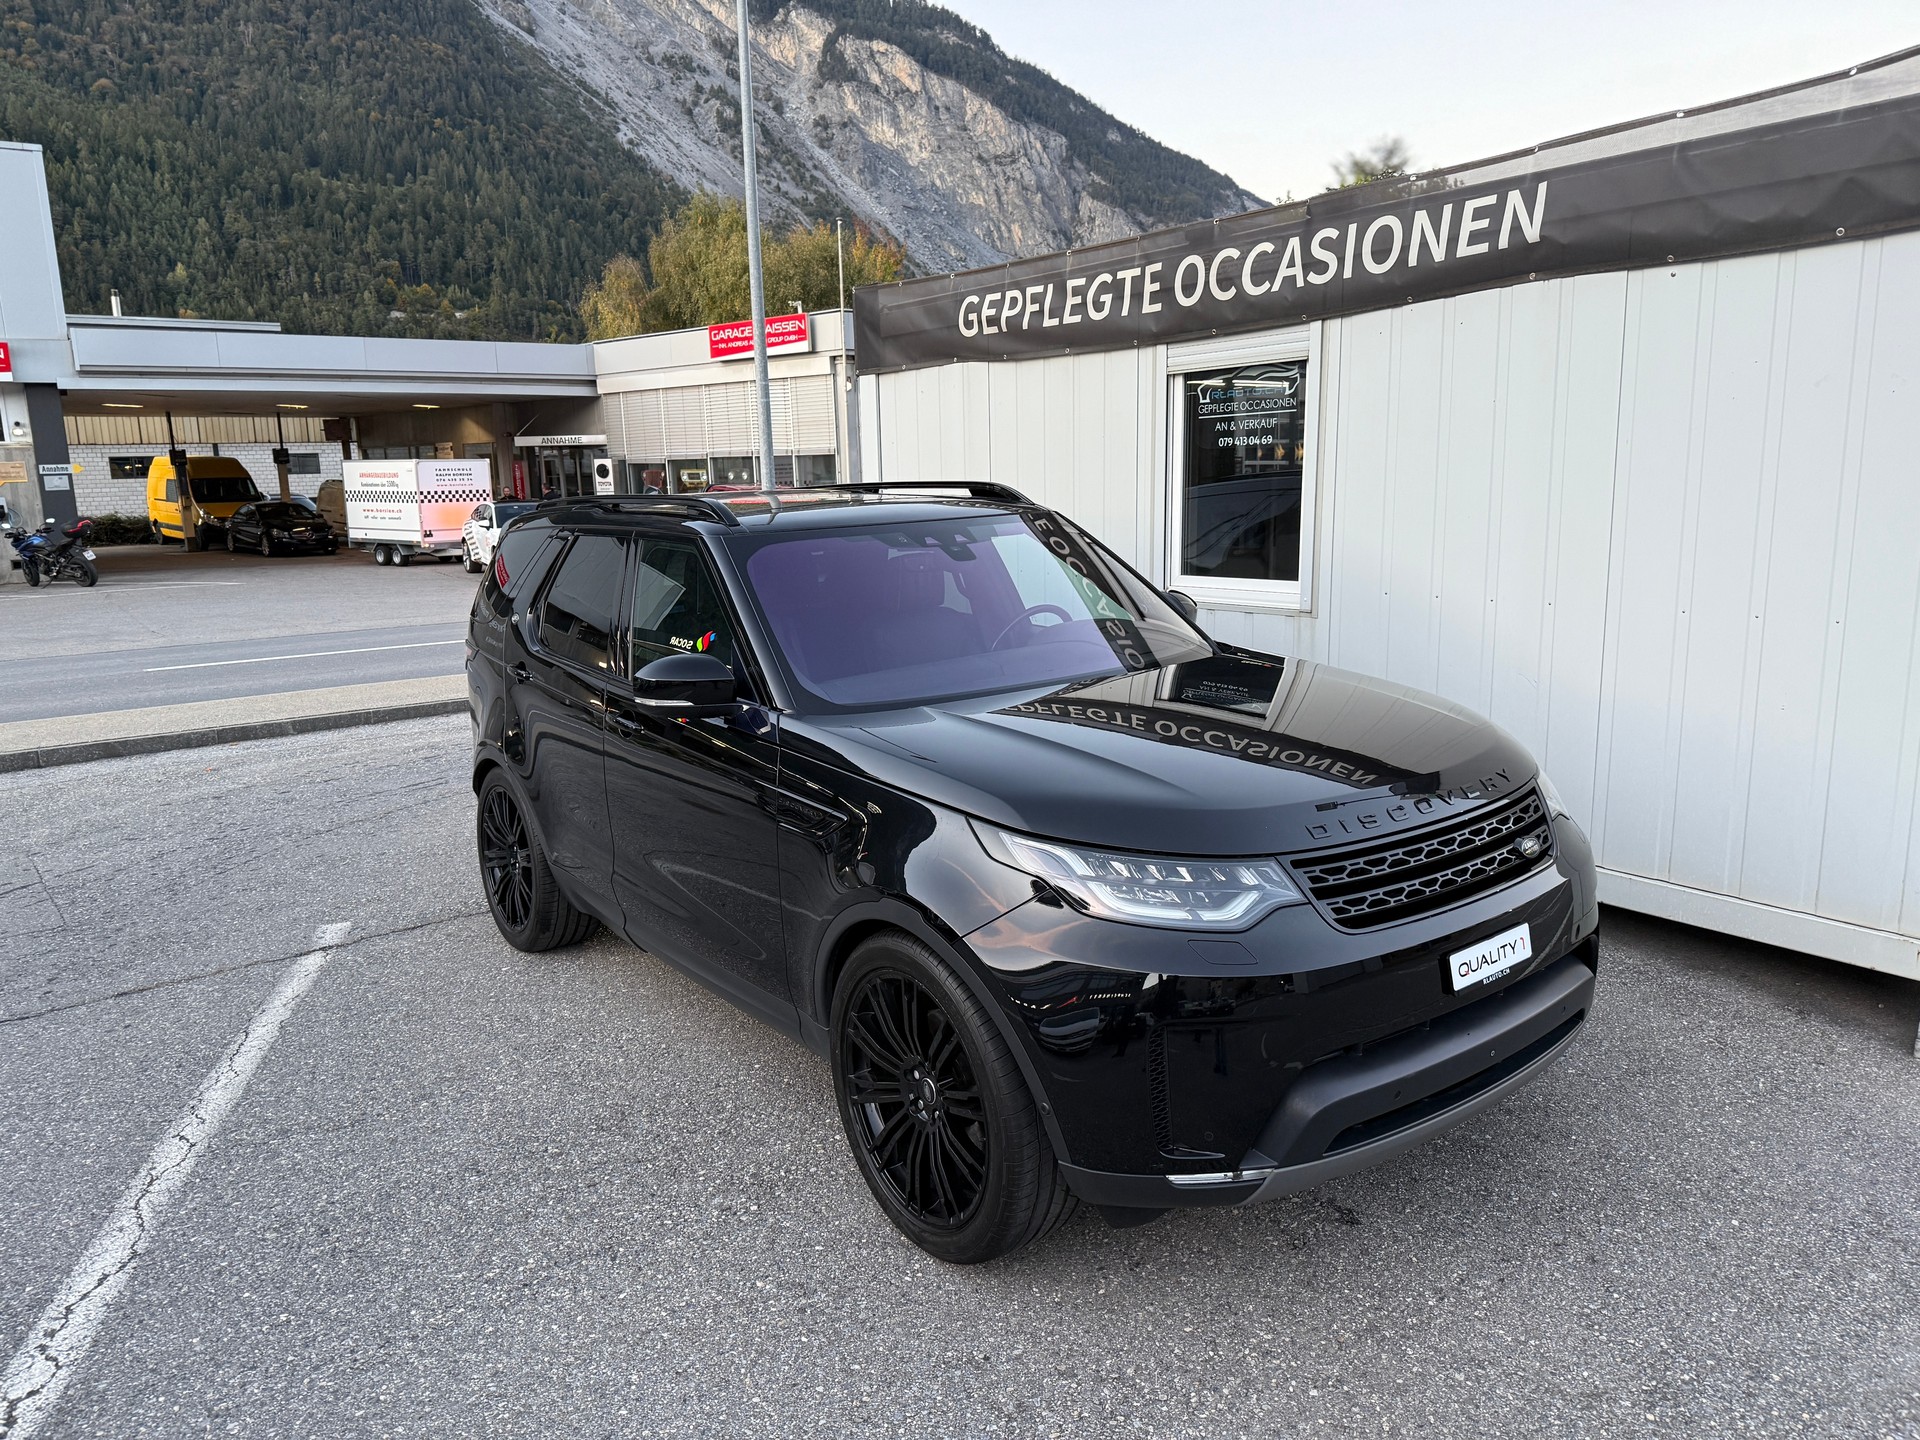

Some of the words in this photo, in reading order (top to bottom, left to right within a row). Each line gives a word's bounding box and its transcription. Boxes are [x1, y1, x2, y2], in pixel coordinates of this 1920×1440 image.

[957, 261, 1163, 338] GEPFLEGTE
[1174, 181, 1549, 307] OCCASIONEN
[711, 326, 753, 341] GARAGE
[765, 319, 805, 334] AISSEN
[727, 340, 748, 348] ANDREAS
[767, 335, 783, 343] GROUP
[1198, 401, 1239, 414] GEPFLEGTE
[1240, 397, 1297, 410] OCCASIONEN
[1214, 421, 1228, 431] AN
[1229, 421, 1236, 431] &
[1238, 418, 1278, 430] VERKAUF
[541, 436, 583, 445] ANNAHME
[1218, 437, 1233, 447] 079
[1234, 436, 1248, 446] 413
[1248, 435, 1260, 445] 04
[1261, 434, 1273, 445] 69
[41, 465, 69, 473] Annahme
[1305, 768, 1512, 840] DISCOVERY
[1458, 939, 1518, 978] QUALITY
[1482, 967, 1511, 985] RLAUTO.CH
